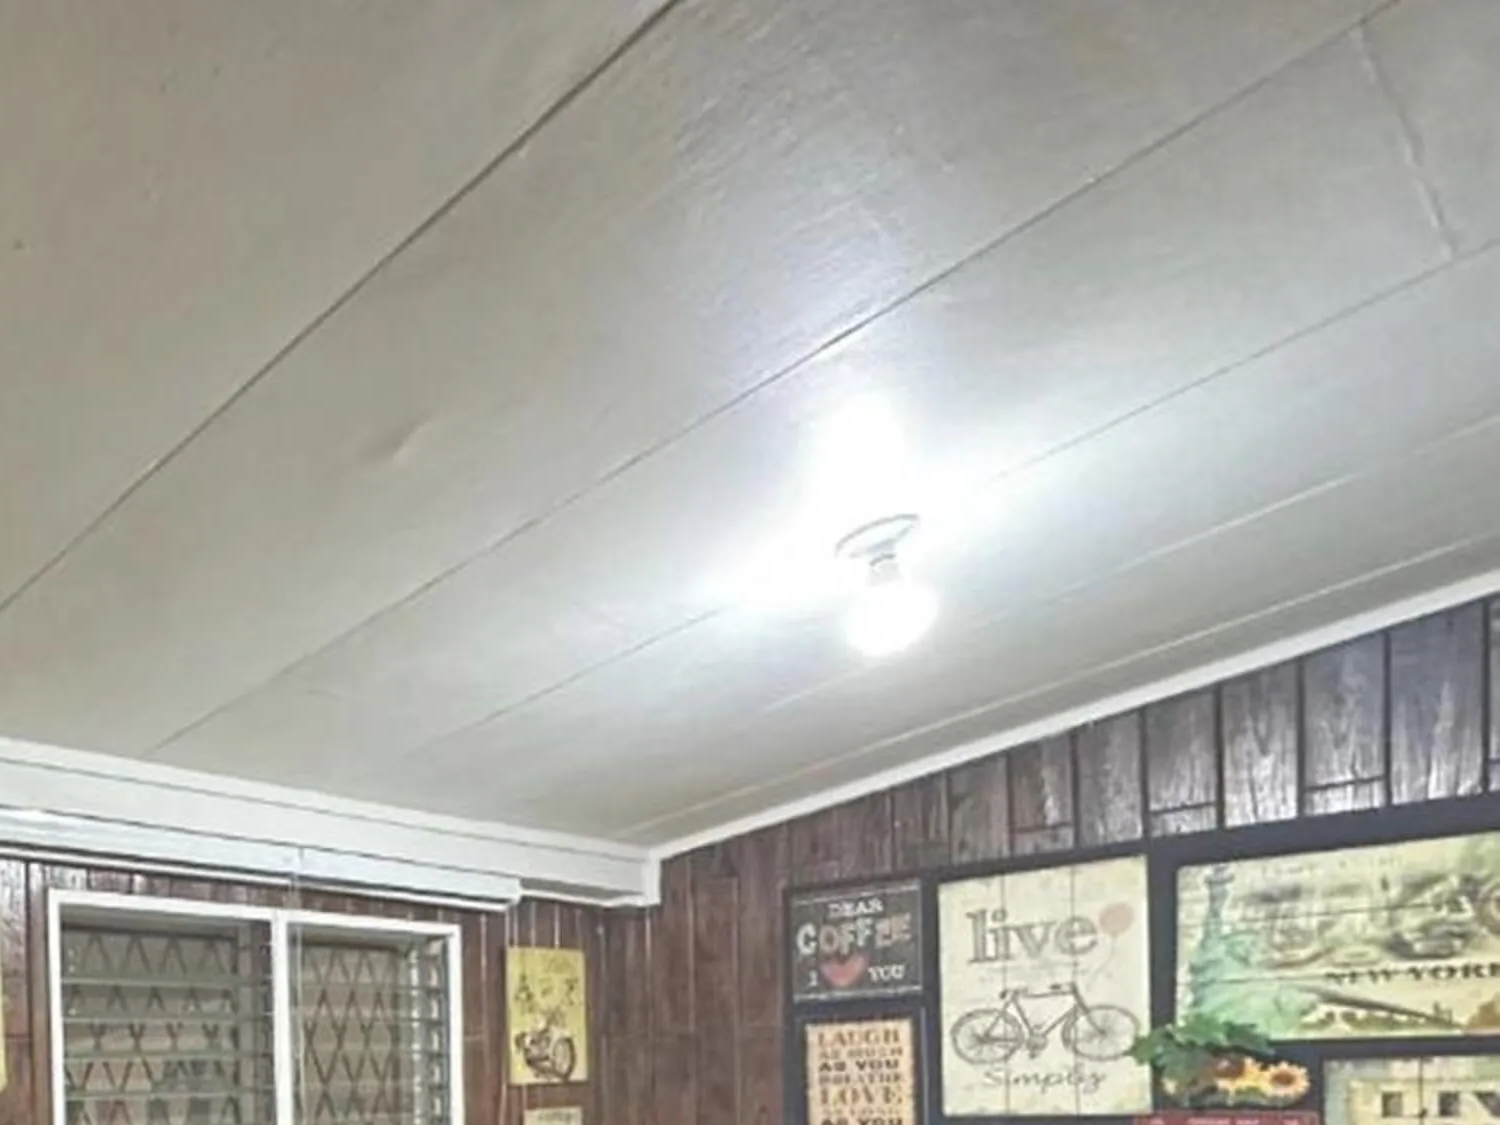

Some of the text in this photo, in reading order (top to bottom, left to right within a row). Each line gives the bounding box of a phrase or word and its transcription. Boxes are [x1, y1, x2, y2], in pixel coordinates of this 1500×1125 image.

[796, 912, 912, 956] COFFEE
[966, 907, 1099, 965] live
[867, 965, 905, 982] YOU
[856, 1059, 899, 1072] YOU
